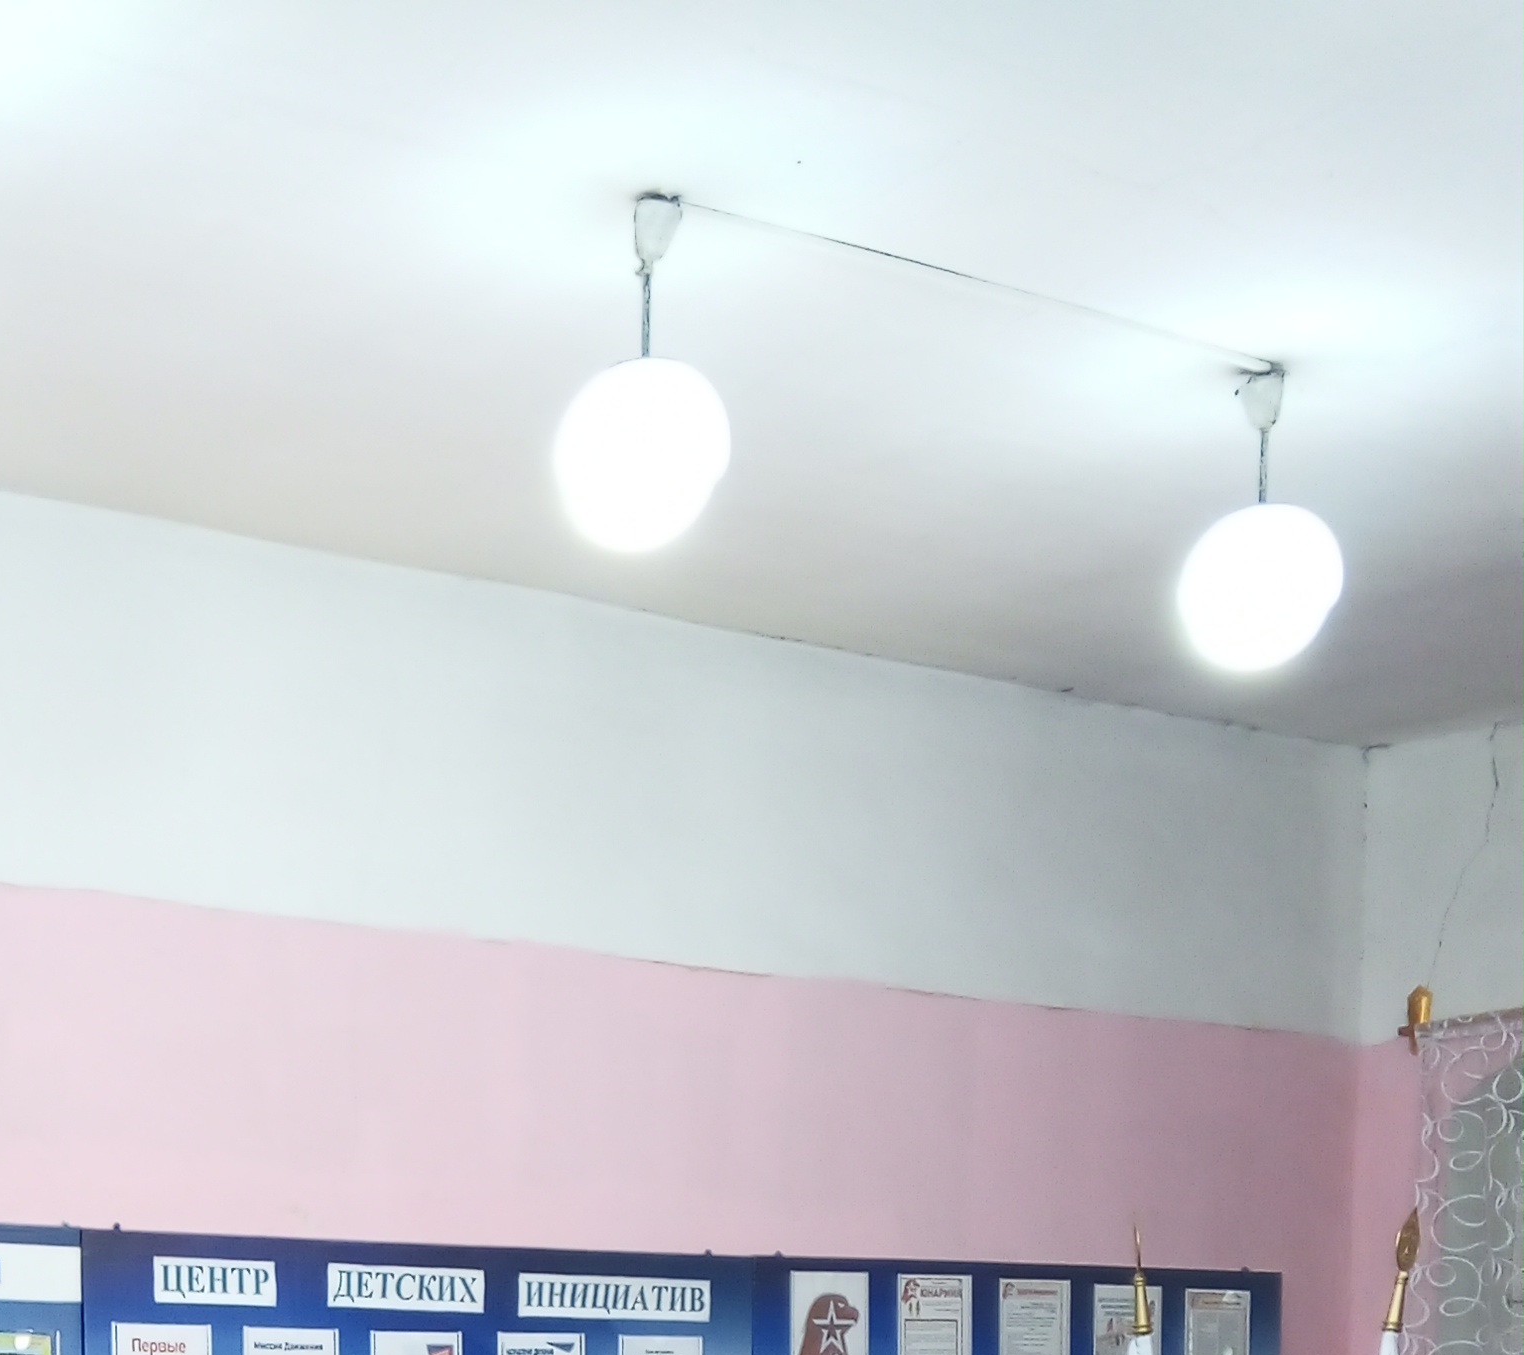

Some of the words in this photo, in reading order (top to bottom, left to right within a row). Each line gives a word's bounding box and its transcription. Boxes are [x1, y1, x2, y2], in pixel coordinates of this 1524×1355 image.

[159, 1263, 271, 1298] ЦЕНТР
[333, 1269, 478, 1304] ДЕТСКИХ
[524, 1280, 706, 1316] ИНИЦИАТИВ
